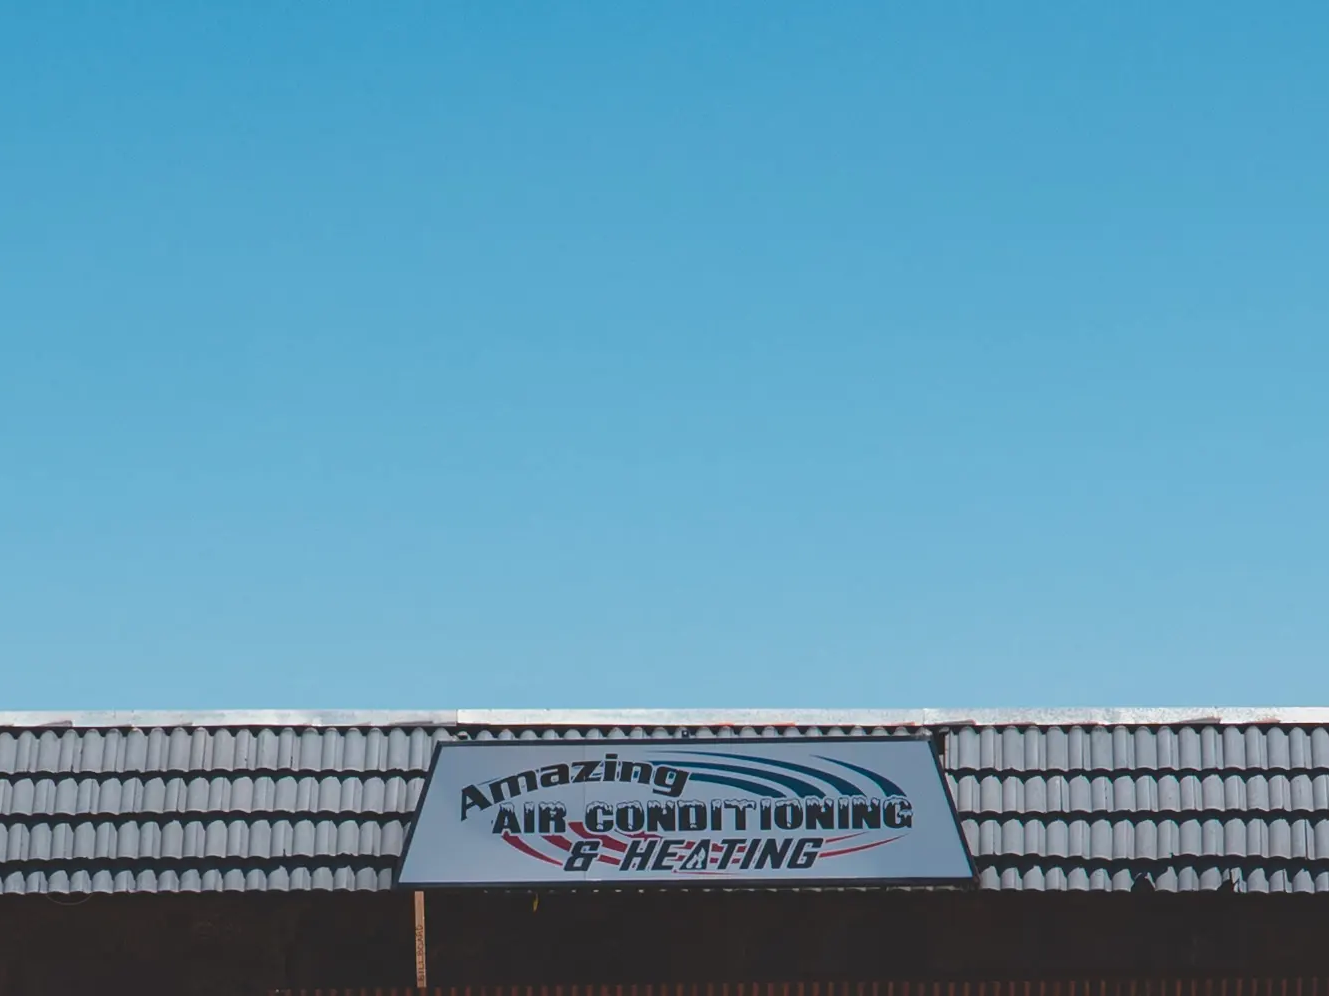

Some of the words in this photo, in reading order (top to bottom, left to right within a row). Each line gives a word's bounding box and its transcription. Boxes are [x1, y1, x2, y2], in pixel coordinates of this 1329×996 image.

[460, 753, 691, 821] Amazing
[491, 800, 568, 834] AIR
[584, 794, 913, 833] CONDITIONING
[563, 840, 600, 872] &
[619, 837, 826, 872] HEATING
